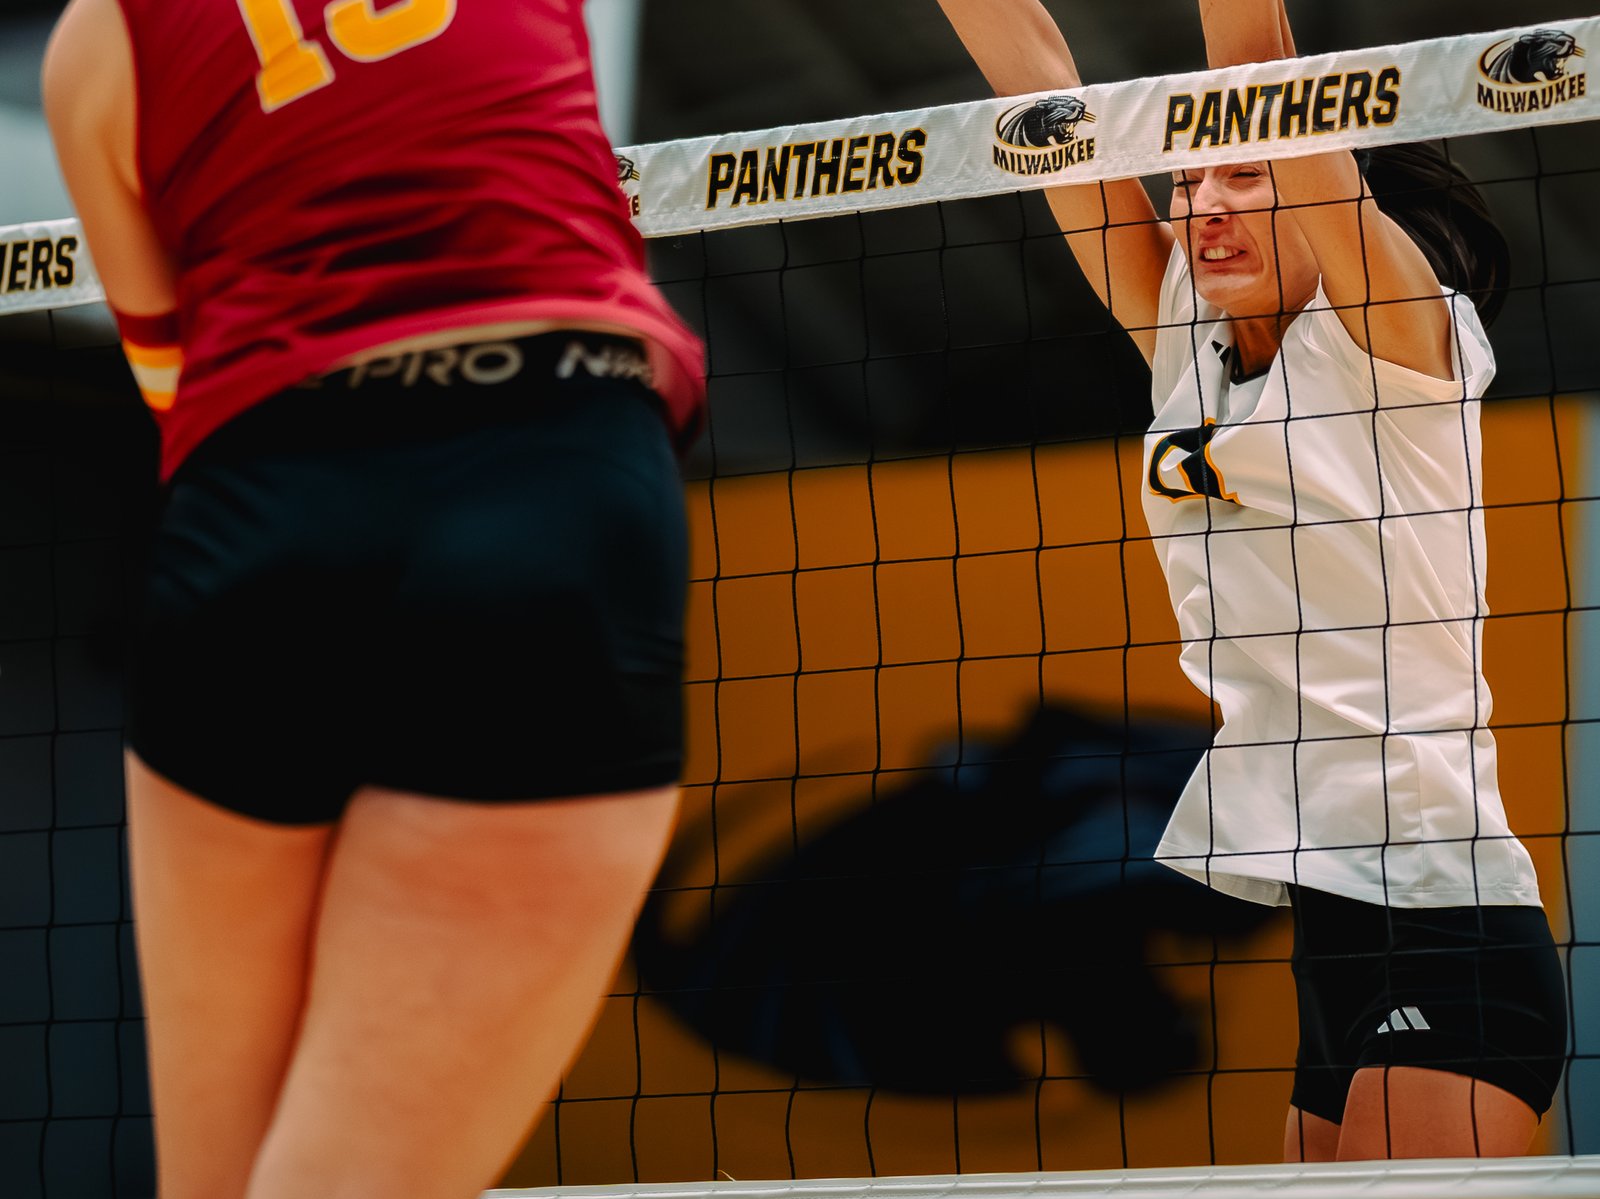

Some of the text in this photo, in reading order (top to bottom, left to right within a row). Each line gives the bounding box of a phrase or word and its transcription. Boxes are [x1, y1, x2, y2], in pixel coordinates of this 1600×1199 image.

[1162, 66, 1400, 153] PANTHERS
[1477, 72, 1585, 113] MILWAUKEE
[705, 128, 928, 211] PANTHERS
[993, 137, 1096, 176] MILWAUKEE
